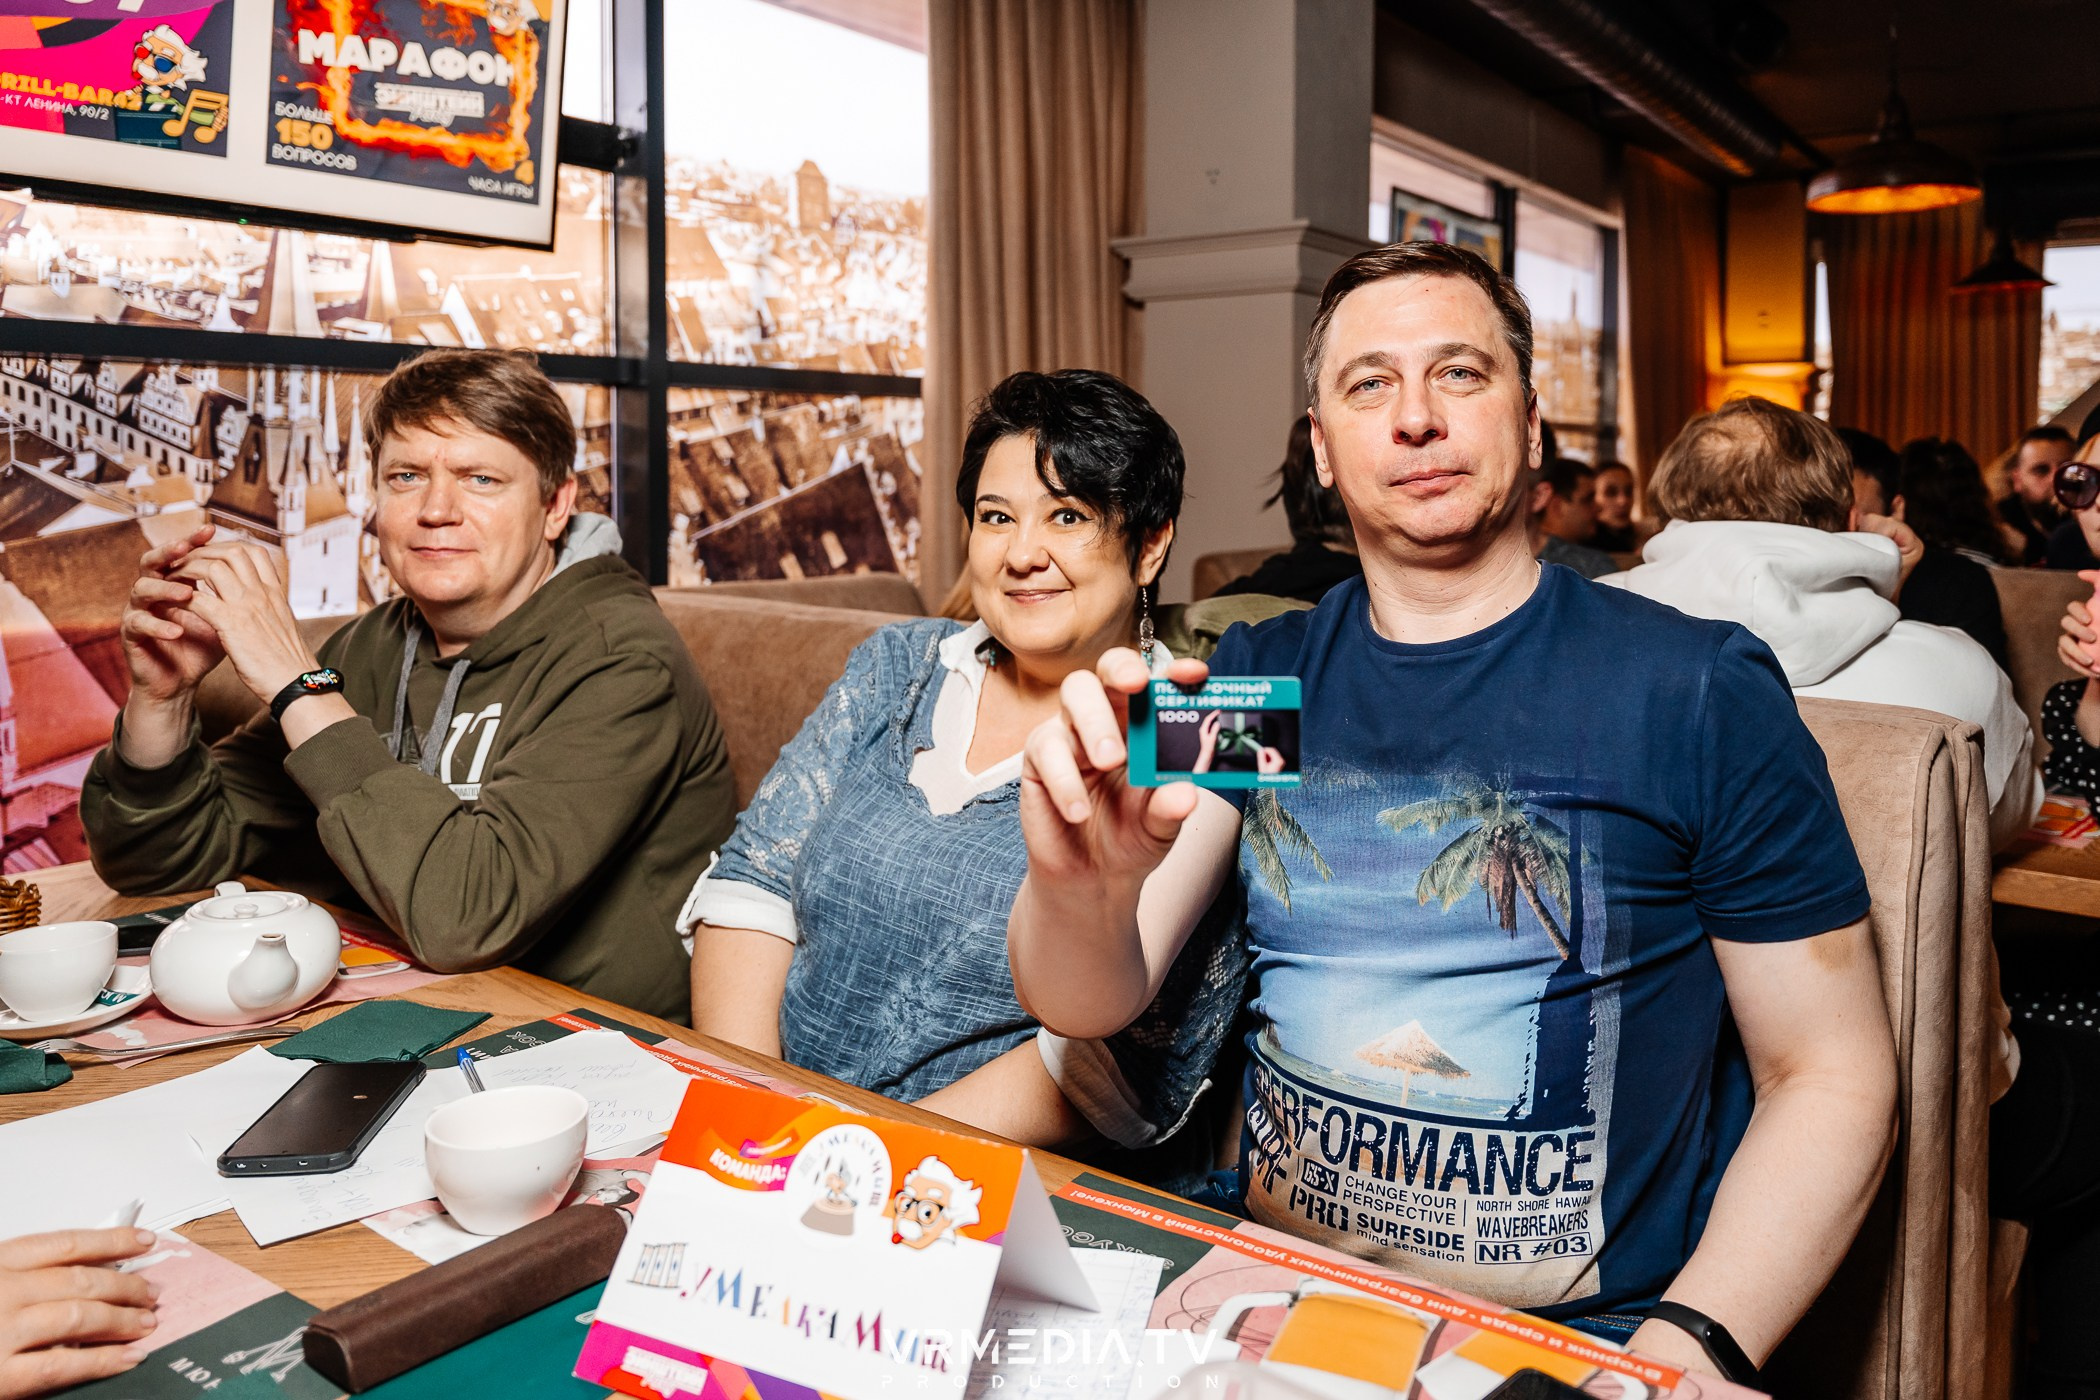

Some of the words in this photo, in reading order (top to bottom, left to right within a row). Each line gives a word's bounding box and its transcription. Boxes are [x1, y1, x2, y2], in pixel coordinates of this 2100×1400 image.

[79, 105, 110, 121] 90/2
[274, 101, 334, 125] БОЛЬШЕ
[274, 117, 333, 150] 150
[271, 143, 357, 170] ВОПРОСОВ
[468, 175, 501, 195] ЧАСА
[502, 181, 534, 199] ИГРЫ
[1154, 695, 1267, 708] СЕРТИФИКАТ
[1158, 710, 1200, 724] 1000
[709, 1147, 787, 1184] КОМАНДА:
[1070, 1190, 1151, 1219] Мюнхене!
[1345, 1175, 1408, 1203] CHANGE
[1411, 1191, 1457, 1210] YOUR
[1476, 1200, 1512, 1212] NORTH
[1517, 1199, 1550, 1212] SHORE
[1289, 1184, 1349, 1232] PRO
[1357, 1213, 1465, 1252] SURFSIDE
[1343, 1189, 1456, 1226] PERSPECTIVE
[1476, 1209, 1589, 1239] WAVEBREAKERS
[1164, 1217, 1288, 1264] удовольствий
[1356, 1229, 1388, 1247] mind
[1393, 1241, 1465, 1262] sensation
[1479, 1243, 1522, 1262] NR
[1530, 1236, 1588, 1256] #03
[1288, 1255, 1424, 1305] безграничных
[1427, 1299, 1468, 1317] дни
[1480, 1316, 1545, 1342] среда
[1548, 1337, 1564, 1349] и
[1567, 1343, 1663, 1382] Вторник
